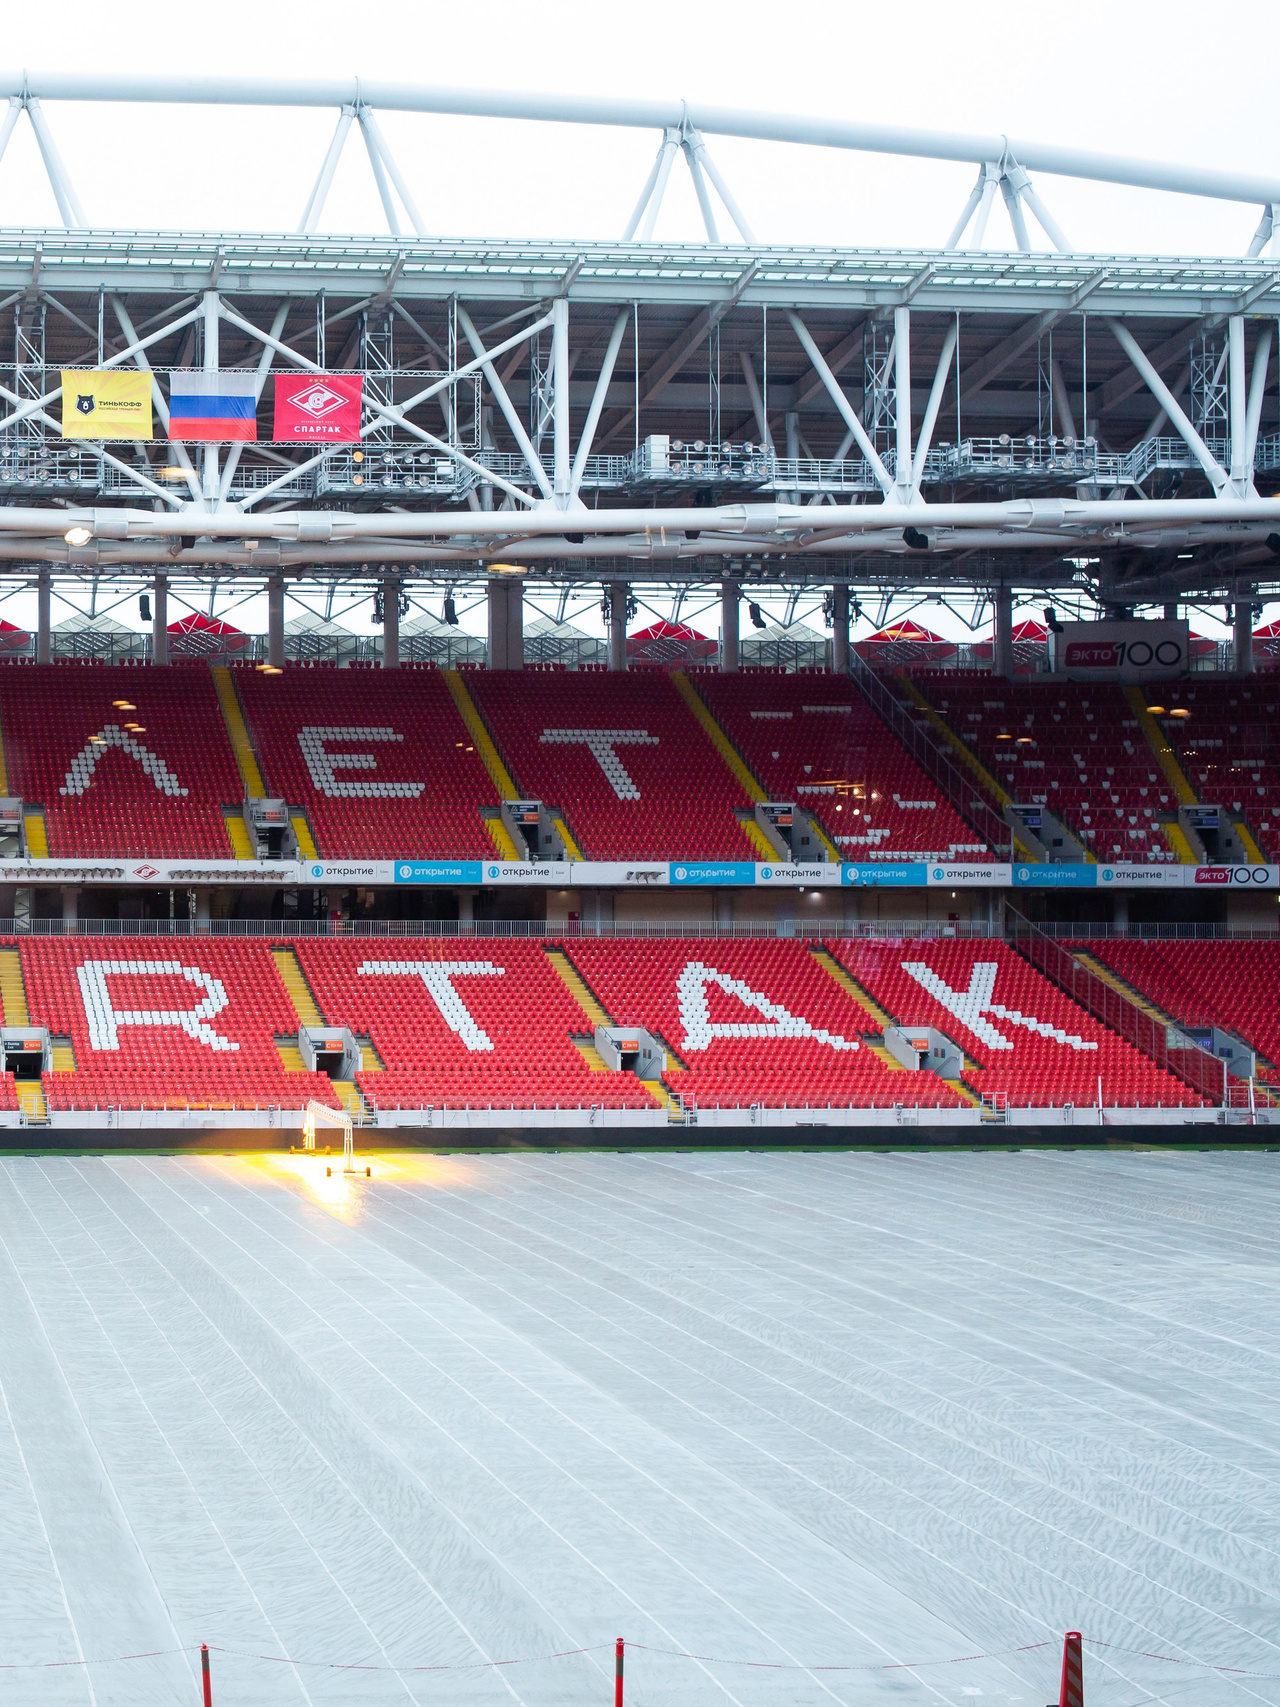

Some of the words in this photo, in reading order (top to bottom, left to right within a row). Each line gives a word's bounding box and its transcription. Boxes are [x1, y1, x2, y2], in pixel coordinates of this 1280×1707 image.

[326, 867, 374, 876] открытие
[414, 868, 462, 876] открытие
[502, 868, 550, 877] открытие
[690, 868, 736, 878] открытие
[775, 870, 822, 878] открытие
[862, 870, 907, 879] открытие
[946, 870, 992, 880] открытие
[1032, 871, 1076, 880] открытие
[1116, 871, 1162, 880] открытие
